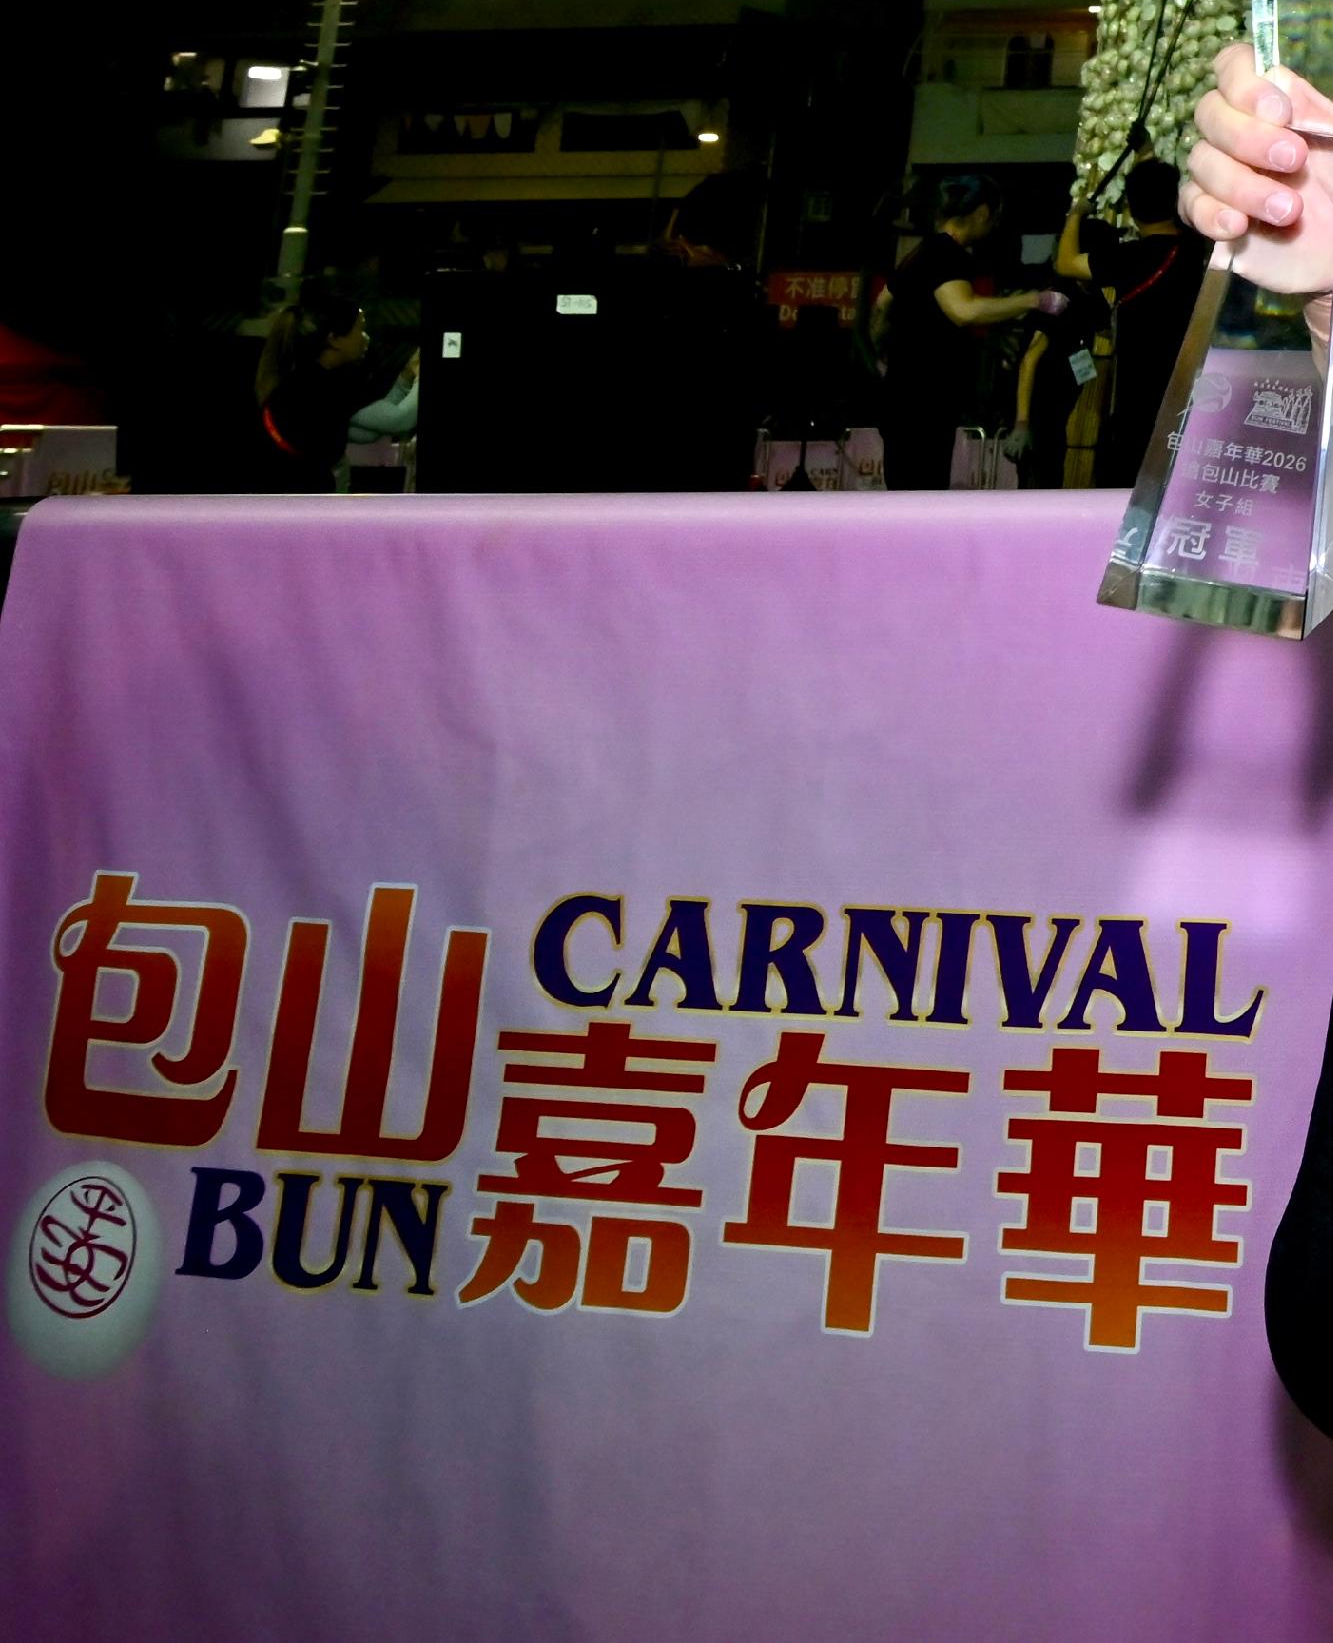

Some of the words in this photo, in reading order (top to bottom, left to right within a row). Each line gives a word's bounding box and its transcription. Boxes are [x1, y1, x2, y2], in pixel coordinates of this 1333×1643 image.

[1166, 516, 1266, 572] 冠軍
[1193, 489, 1254, 516] 女子組
[45, 869, 492, 1162] 包山
[531, 892, 1268, 1041] CARNIVAL
[175, 1165, 452, 1298] BUN
[456, 1022, 1255, 1353] 嘉年華
